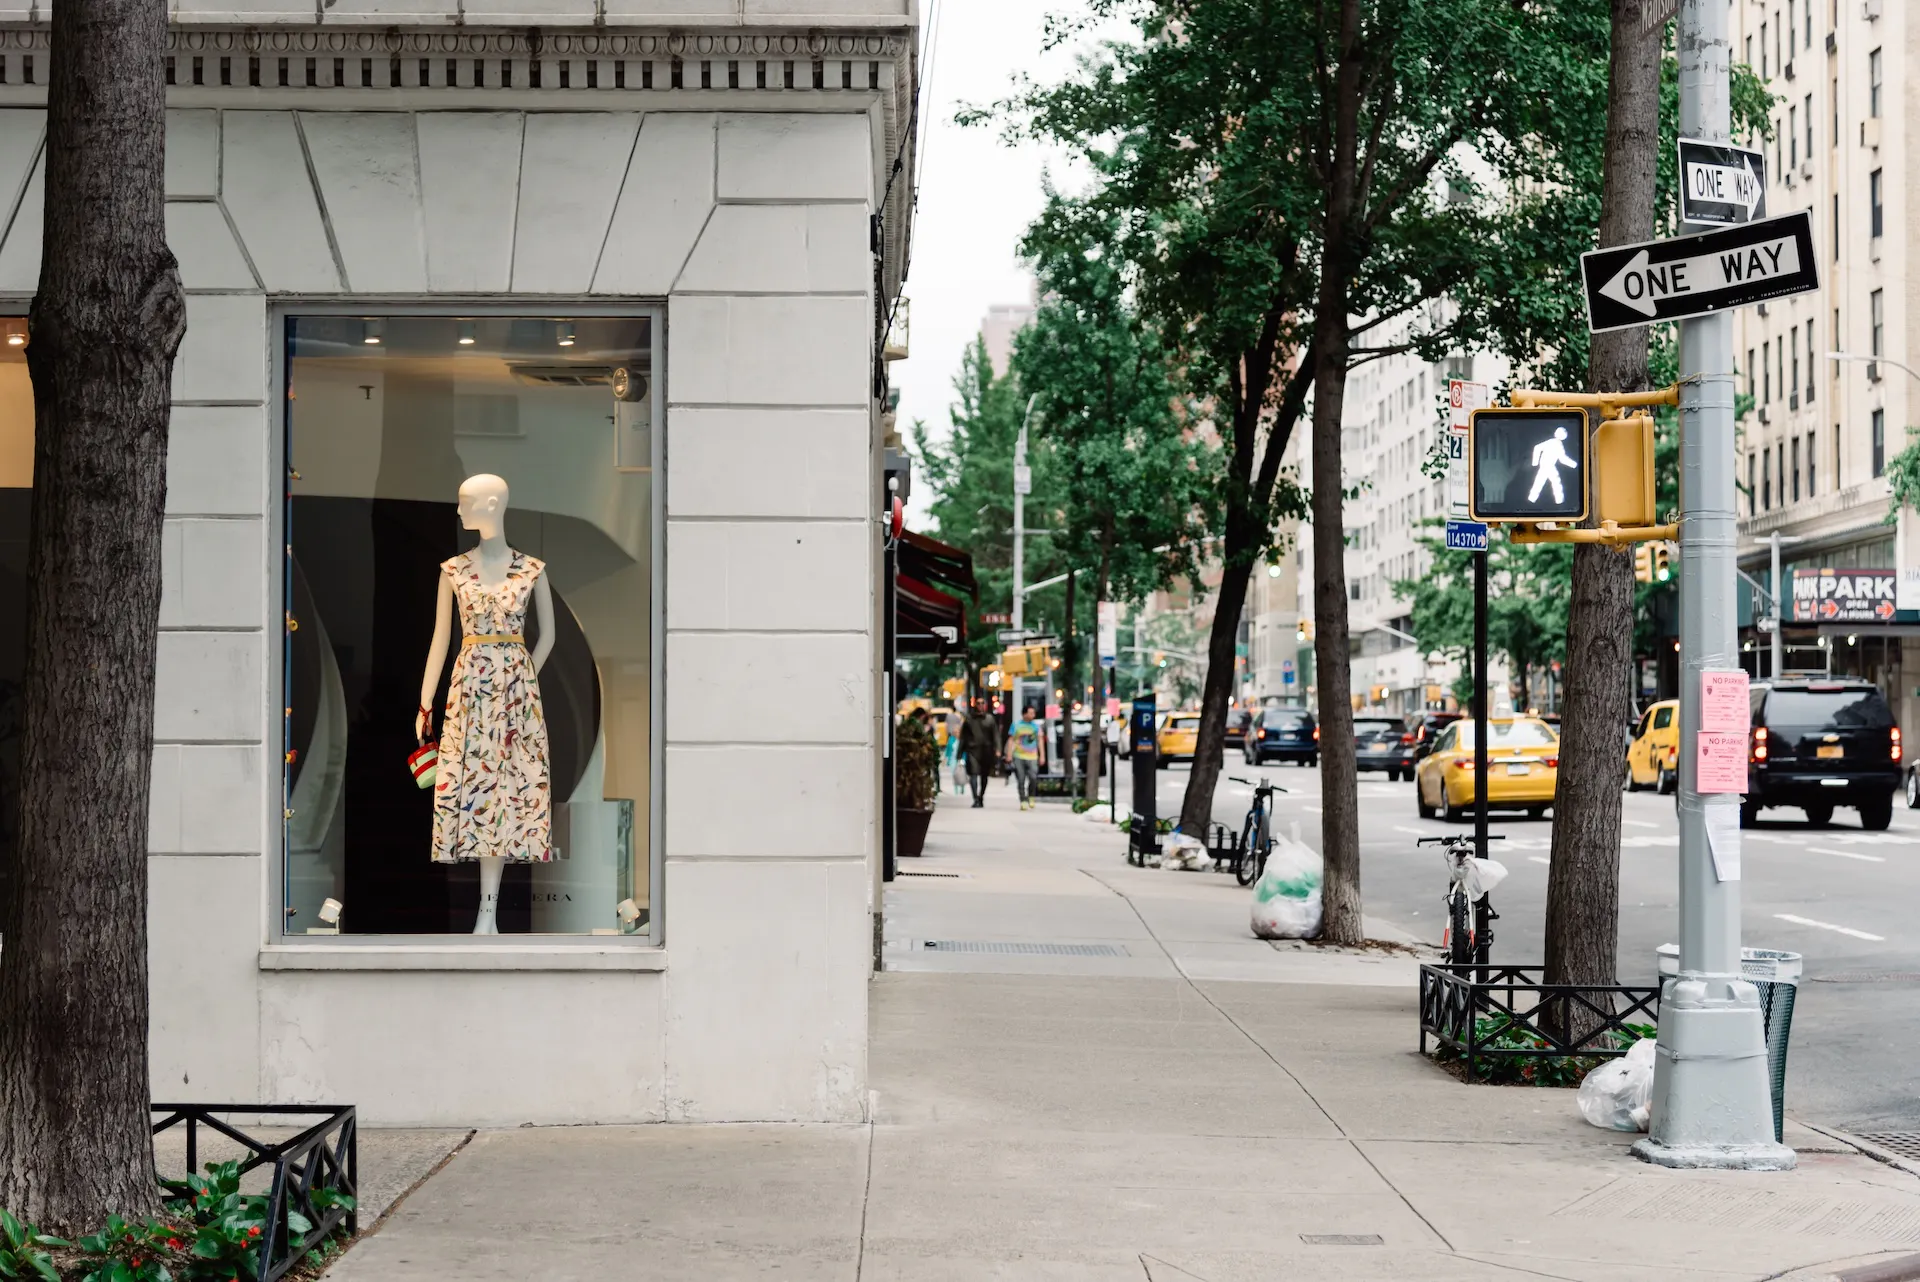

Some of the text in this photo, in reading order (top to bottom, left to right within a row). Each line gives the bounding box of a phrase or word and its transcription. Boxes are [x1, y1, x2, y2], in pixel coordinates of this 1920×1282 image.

[1695, 168, 1755, 203] ONE WAY
[1624, 243, 1783, 300] ONE WAY
[1761, 284, 1810, 298] TRANSPORTATION
[1452, 437, 1461, 458] 2
[1447, 532, 1476, 547] 114370
[1793, 576, 1819, 600] PARK
[1819, 576, 1895, 599] PARK
[1846, 600, 1869, 610] OPEN
[1849, 610, 1875, 620] HOURS
[1712, 677, 1744, 686] NO PARKING
[1708, 737, 1743, 746] NO PARKING
